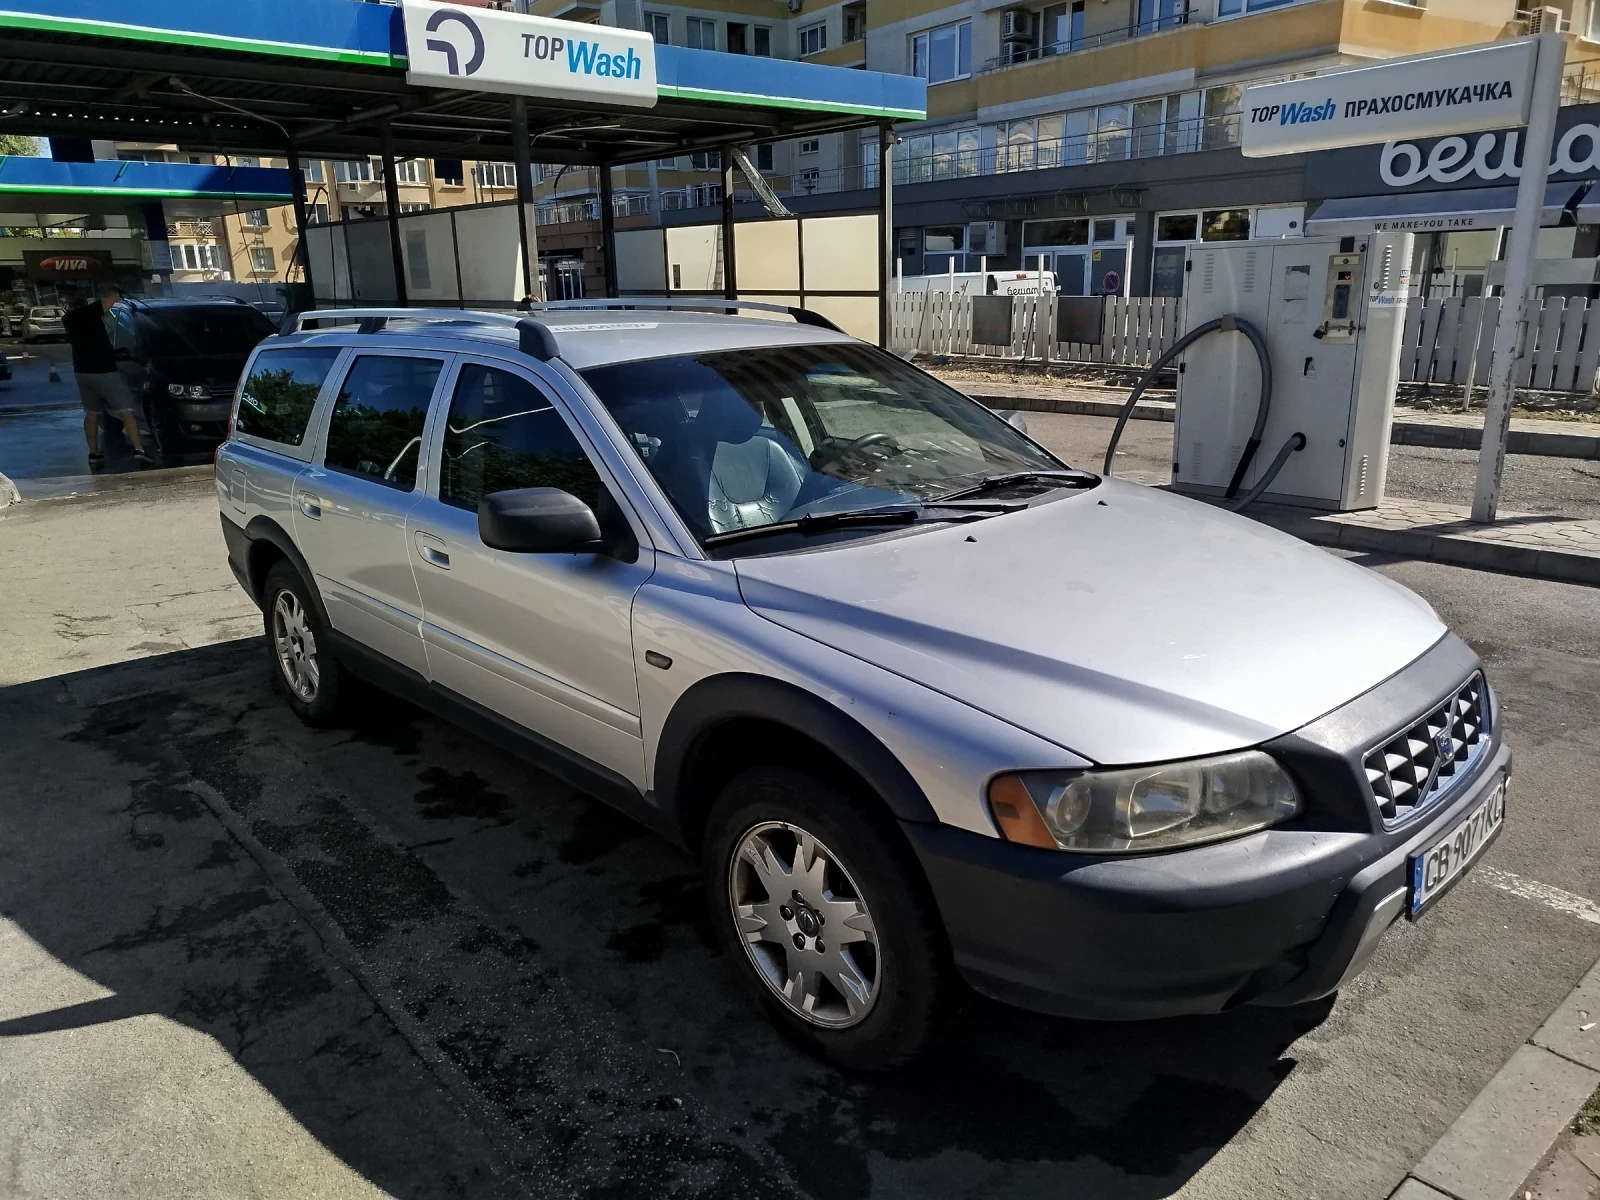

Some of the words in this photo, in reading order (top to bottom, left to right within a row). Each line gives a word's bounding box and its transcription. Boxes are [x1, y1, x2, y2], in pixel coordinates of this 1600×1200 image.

[1344, 80, 1513, 119] ПРАХОСМУКАЧКА
[1374, 221, 1388, 230] WE
[1391, 219, 1444, 230] MAKE-YOU
[1447, 217, 1474, 227] TAKE
[55, 259, 88, 271] VIVA
[1425, 843, 1450, 893] CB
